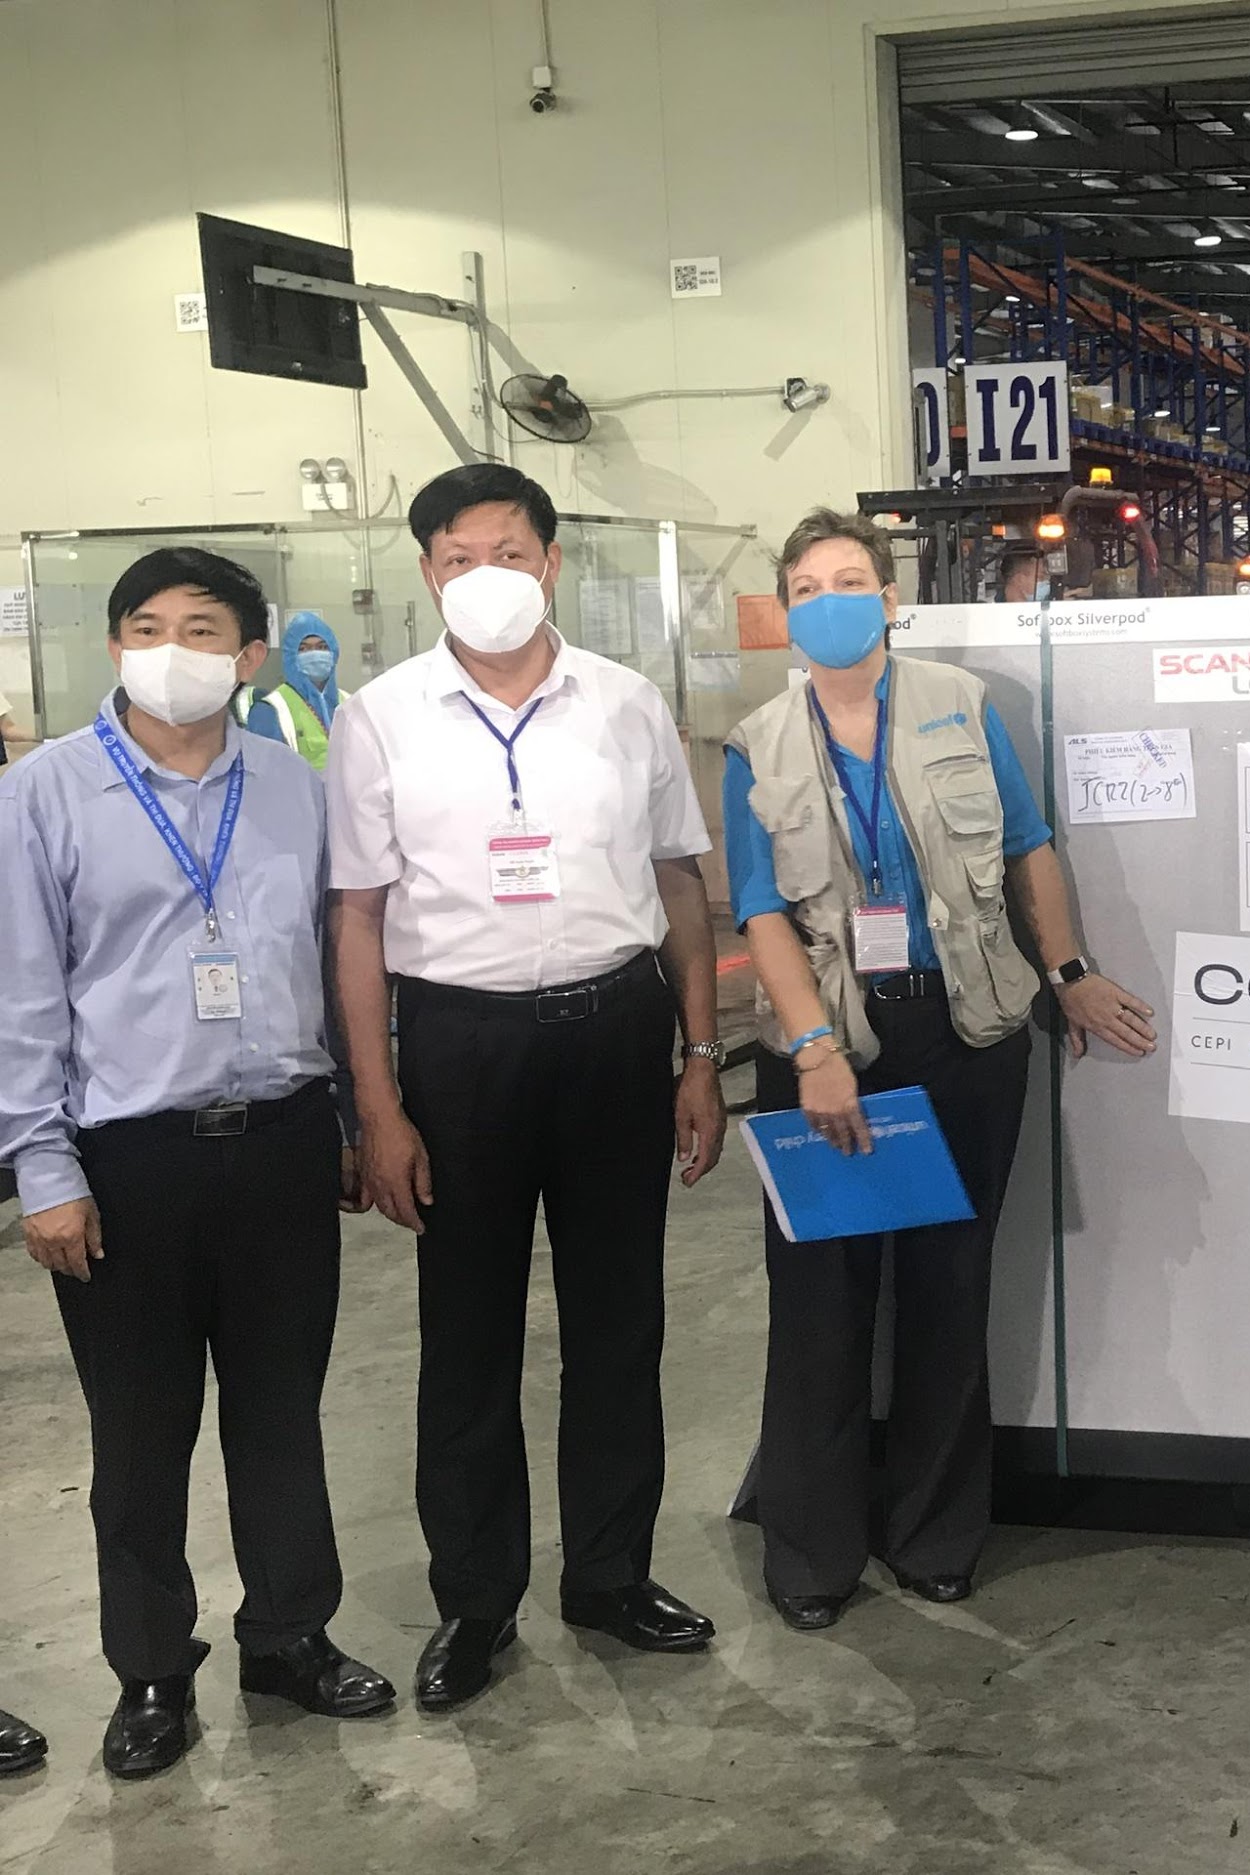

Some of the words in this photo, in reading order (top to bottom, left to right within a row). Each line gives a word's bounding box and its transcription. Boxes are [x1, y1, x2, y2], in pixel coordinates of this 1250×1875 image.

[976, 376, 1058, 461] I21
[1017, 614, 1072, 627] Sofox
[1191, 1035, 1231, 1050] CEPI
